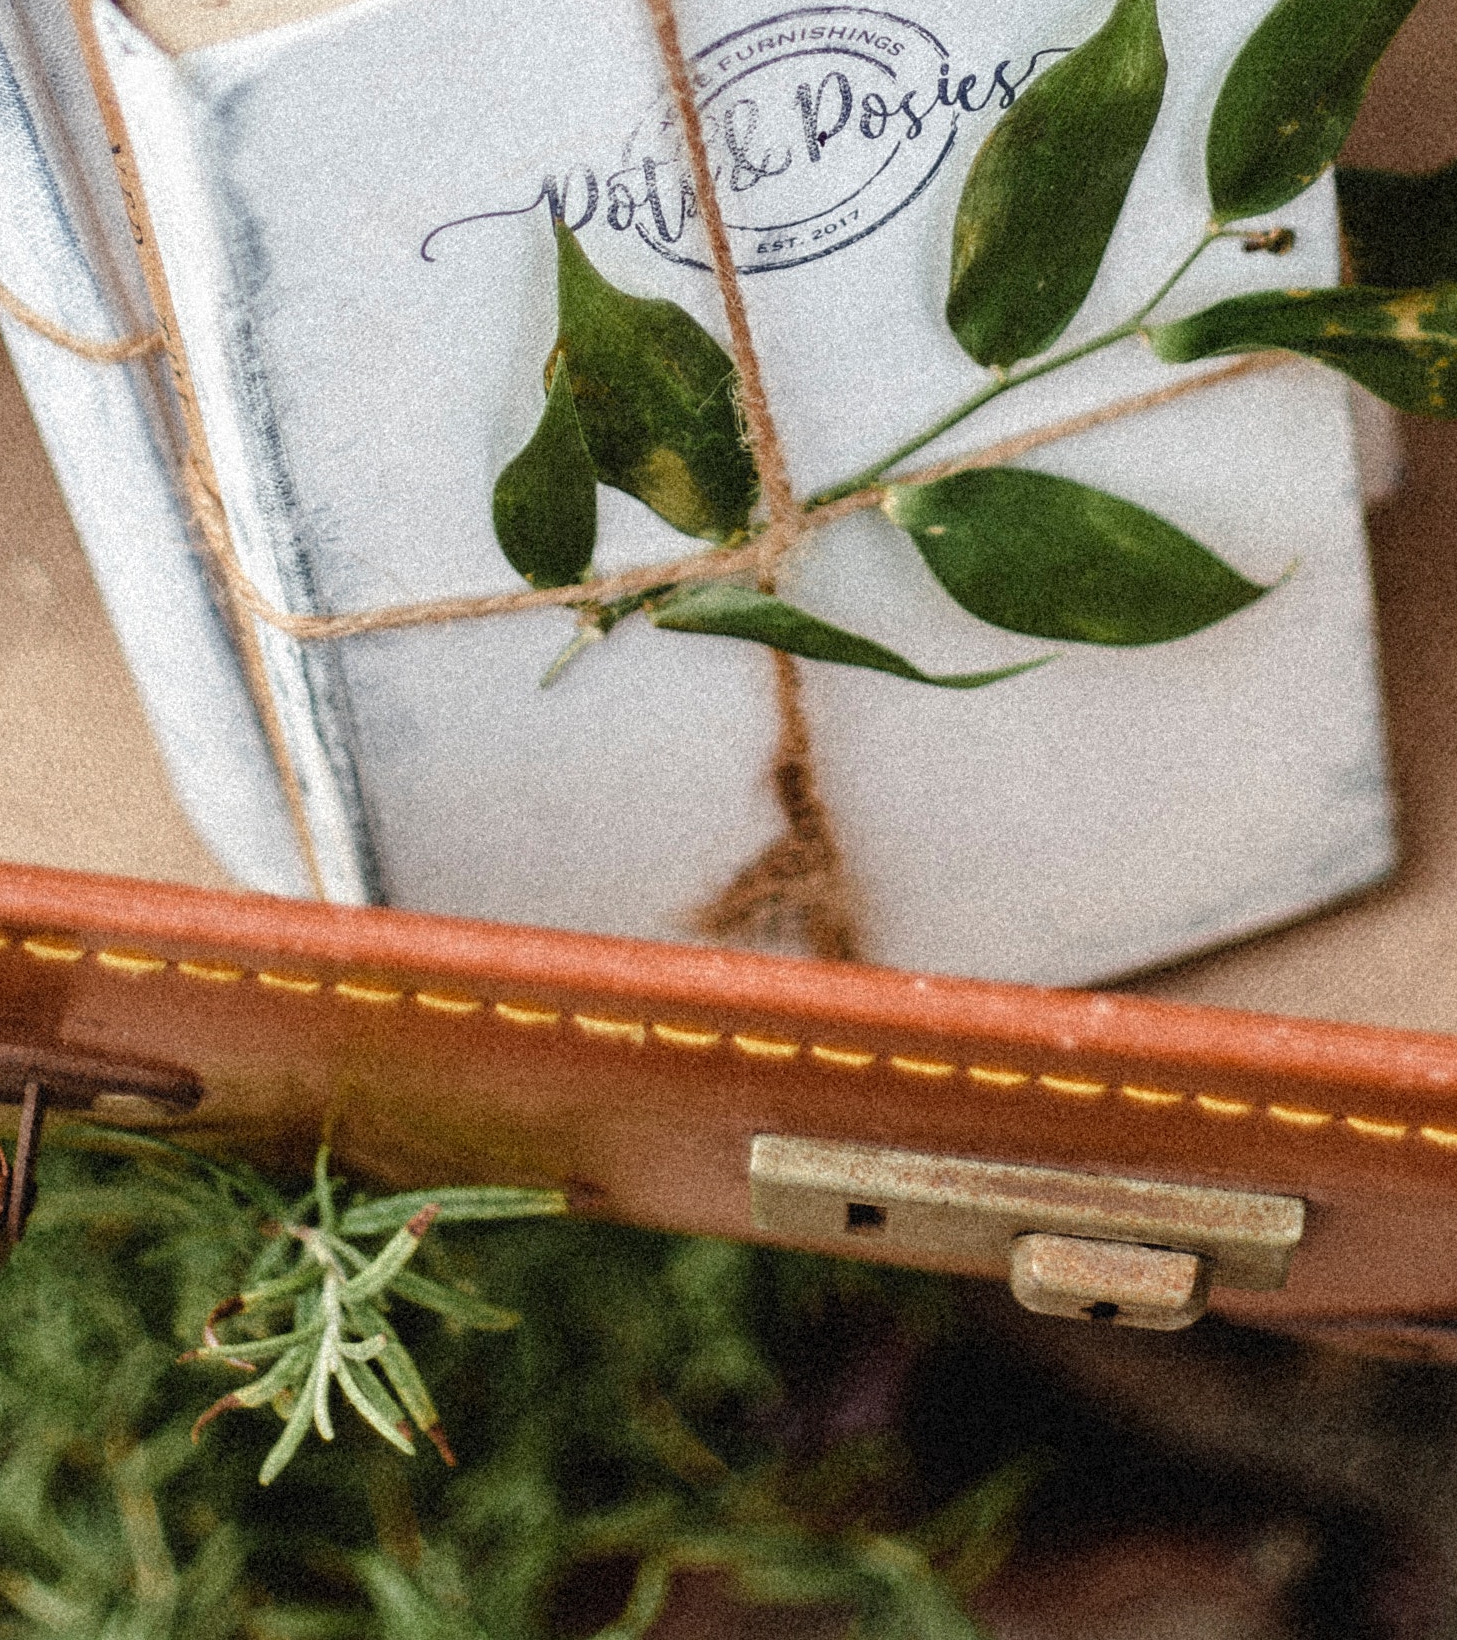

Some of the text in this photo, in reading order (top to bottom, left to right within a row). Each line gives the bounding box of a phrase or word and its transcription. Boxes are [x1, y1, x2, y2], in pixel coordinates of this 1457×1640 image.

[718, 25, 905, 72] FURNISHINGS
[725, 97, 792, 193] &
[795, 46, 1076, 163] Posies
[756, 209, 860, 254] EST. 2017
